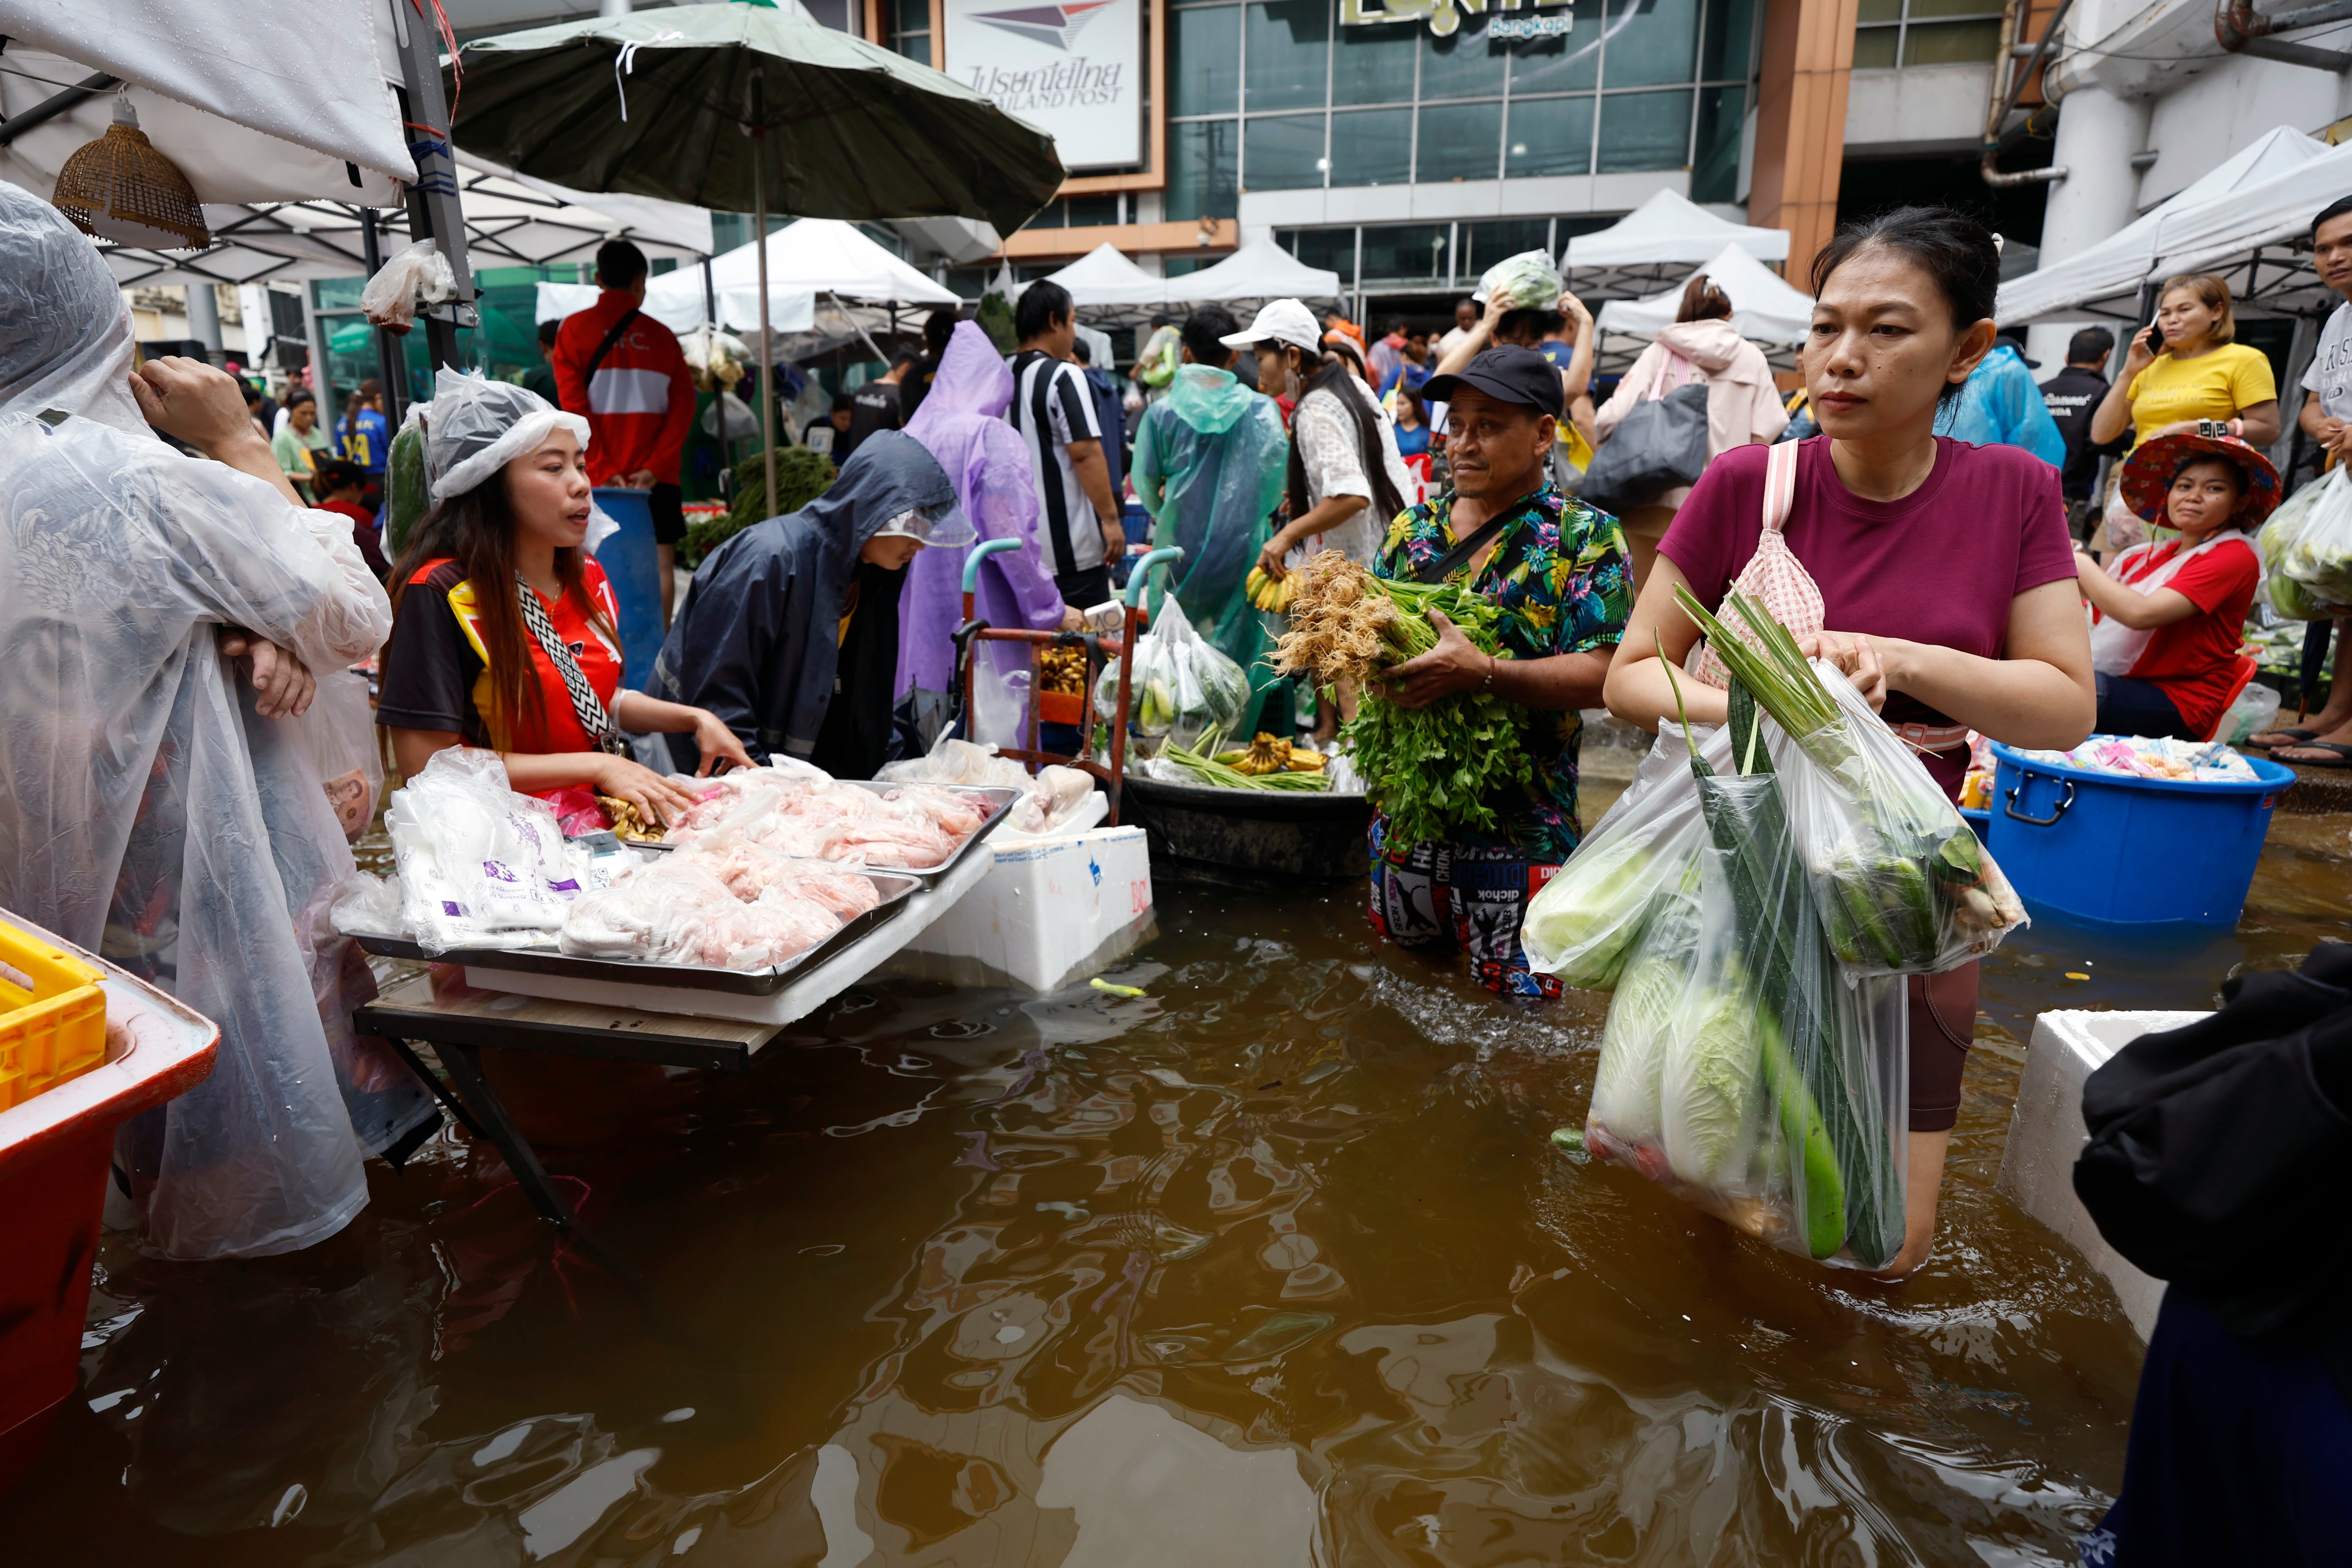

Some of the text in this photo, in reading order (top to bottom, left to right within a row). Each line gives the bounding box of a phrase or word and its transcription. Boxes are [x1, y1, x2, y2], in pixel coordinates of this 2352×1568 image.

[1488, 12, 1573, 39] Bangkapi
[1069, 87, 1123, 107] POST
[1095, 610, 1121, 634] 10
[1478, 890, 1520, 902] dichok
